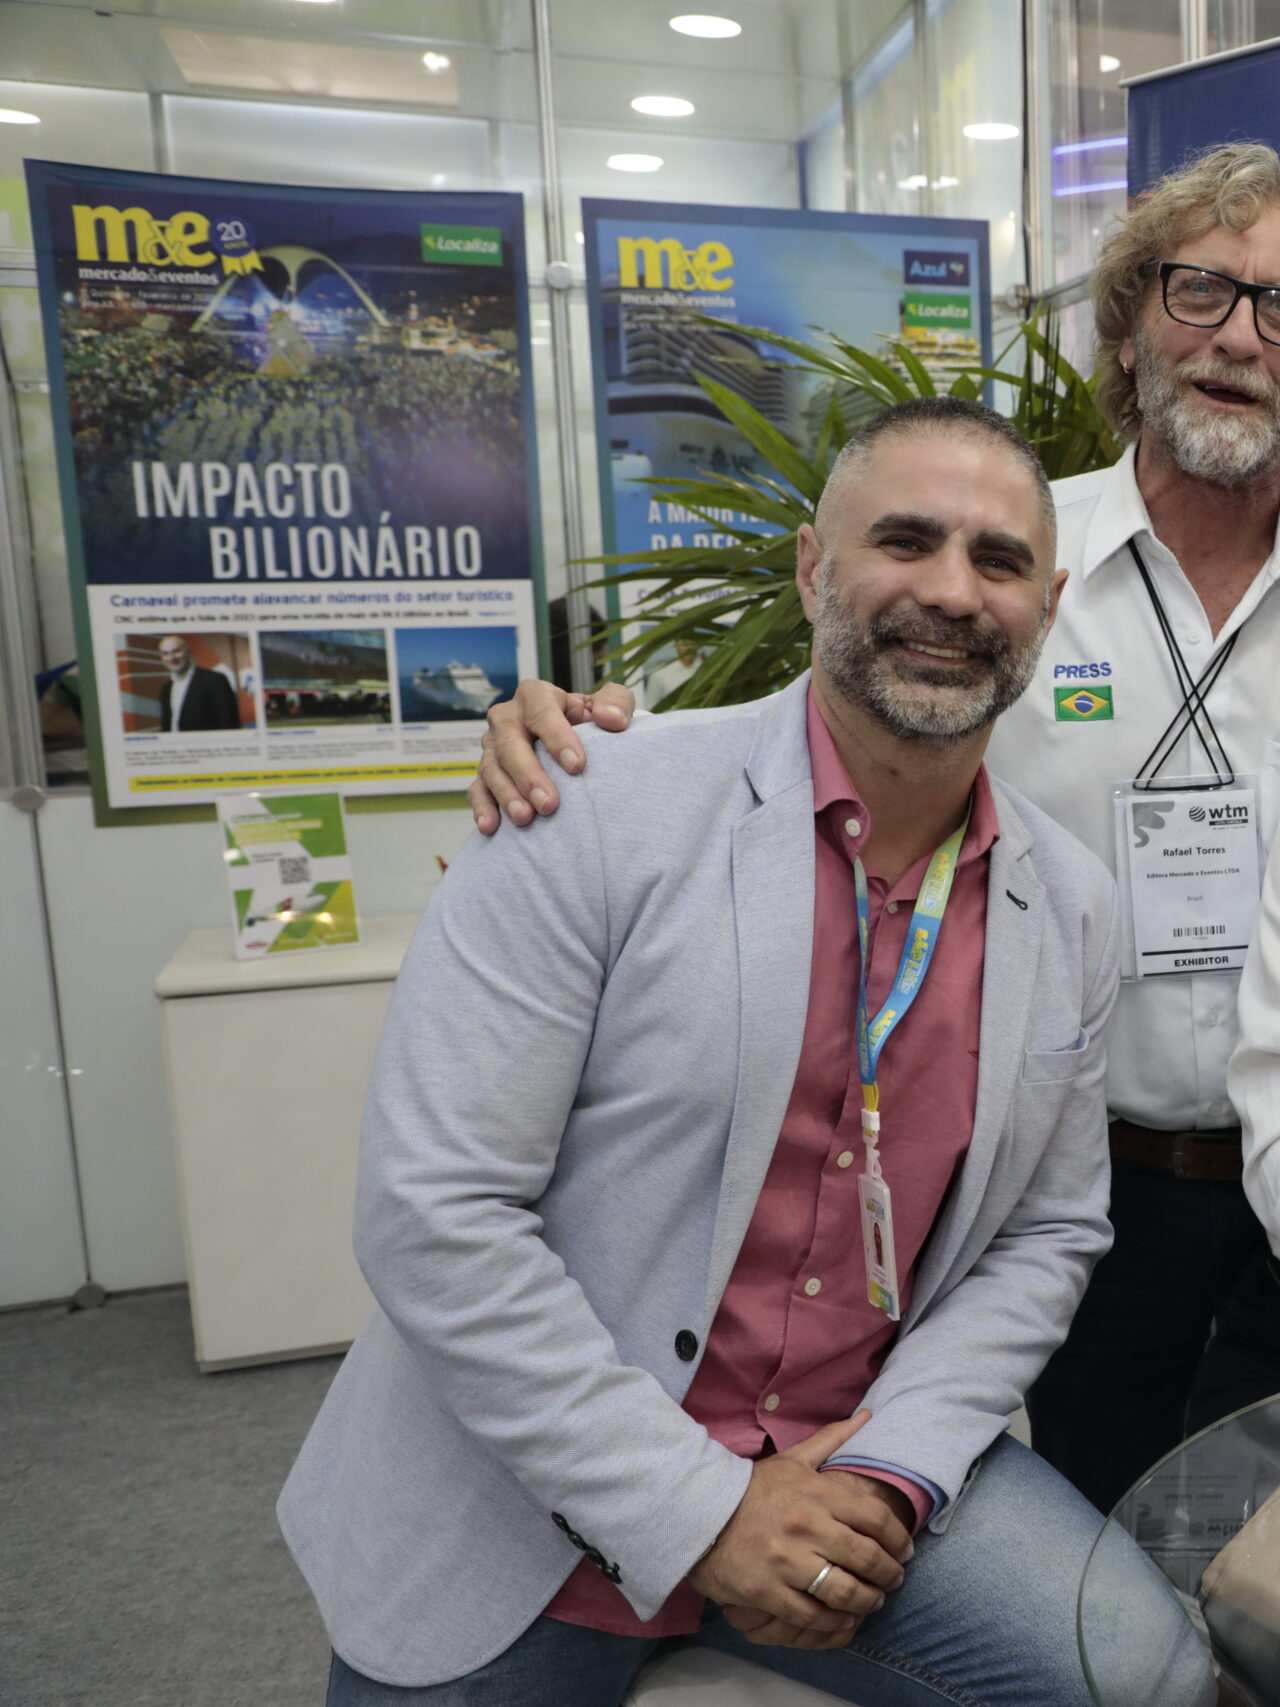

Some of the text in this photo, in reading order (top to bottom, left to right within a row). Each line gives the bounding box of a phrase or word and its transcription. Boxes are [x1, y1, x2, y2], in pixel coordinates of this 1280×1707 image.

[437, 235, 499, 254] Localiza
[910, 260, 948, 278] Azul
[918, 303, 969, 319] Localiza
[132, 461, 352, 519] IMPACTO
[209, 511, 483, 580] BILIONÁRIO
[110, 594, 178, 607] Carnaval
[183, 594, 246, 609] promete
[327, 589, 390, 604] números
[394, 589, 412, 603] do
[418, 589, 451, 602] setor
[457, 587, 514, 601] turístico
[1054, 661, 1113, 679] PRESS
[1208, 804, 1248, 819] wtm
[1163, 846, 1226, 857] Rafael Torres
[1174, 956, 1230, 967] EXHIBITOR
